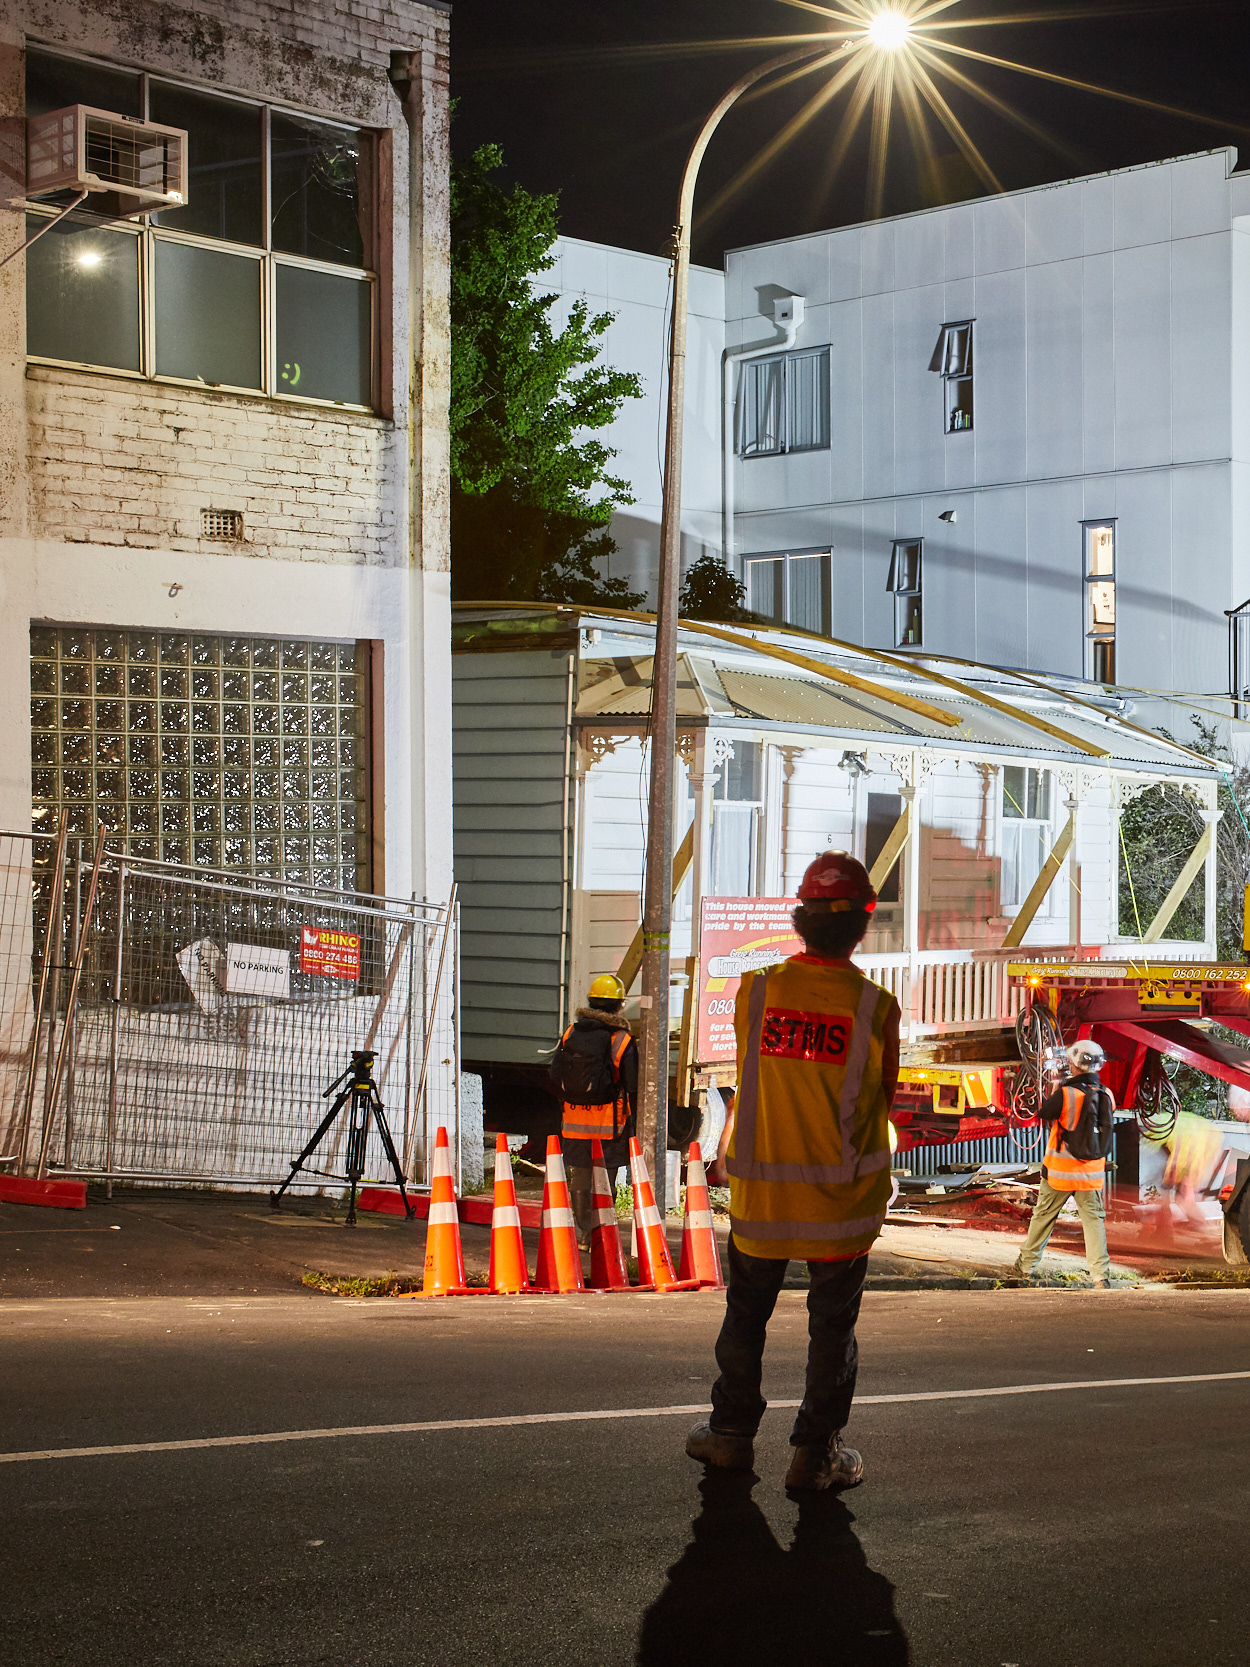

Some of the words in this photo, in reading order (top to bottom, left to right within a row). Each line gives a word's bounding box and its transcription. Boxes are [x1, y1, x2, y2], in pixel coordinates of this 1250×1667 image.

[705, 902, 725, 911] This
[726, 902, 754, 911] house
[755, 903, 786, 911] moved
[727, 912, 746, 920] and
[704, 922, 730, 931] pride
[733, 922, 746, 931] by
[749, 922, 765, 930] the
[768, 922, 792, 930] team
[319, 932, 358, 948] RHINO
[304, 949, 324, 959] 0800
[326, 951, 340, 961] 274
[233, 961, 247, 970] NO
[248, 963, 284, 975] PARKING
[717, 958, 740, 975] House
[1172, 968, 1201, 979] 0800
[1204, 969, 1224, 979] 162
[1225, 970, 1247, 980] 252
[710, 1023, 725, 1032] for
[709, 1033, 720, 1041] or
[764, 1017, 847, 1055] STMS
